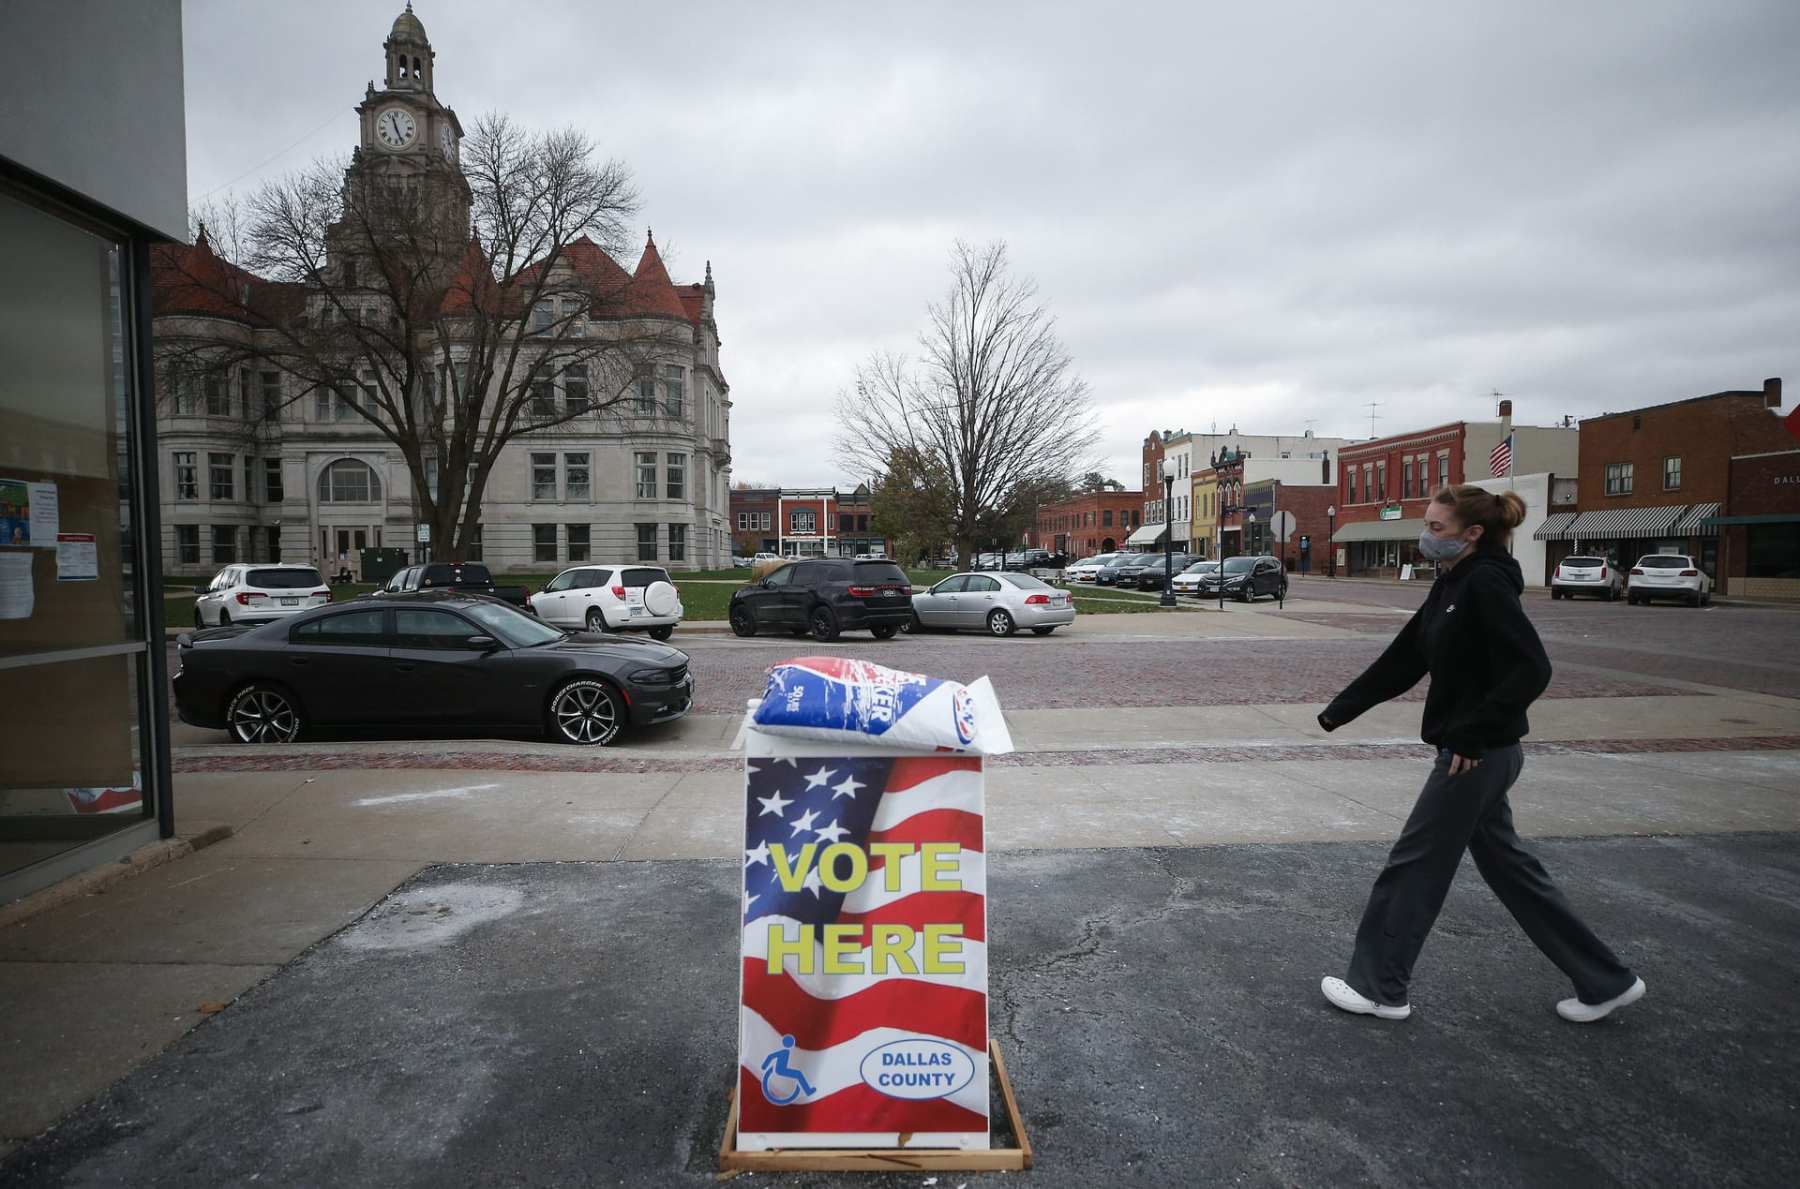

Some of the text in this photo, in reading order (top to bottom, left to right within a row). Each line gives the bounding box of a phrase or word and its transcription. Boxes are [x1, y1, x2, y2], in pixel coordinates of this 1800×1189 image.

[768, 842, 962, 892] VOTE
[767, 923, 965, 976] HERE
[881, 1052, 952, 1066] DALLAS
[878, 1072, 956, 1087] COUNTY
